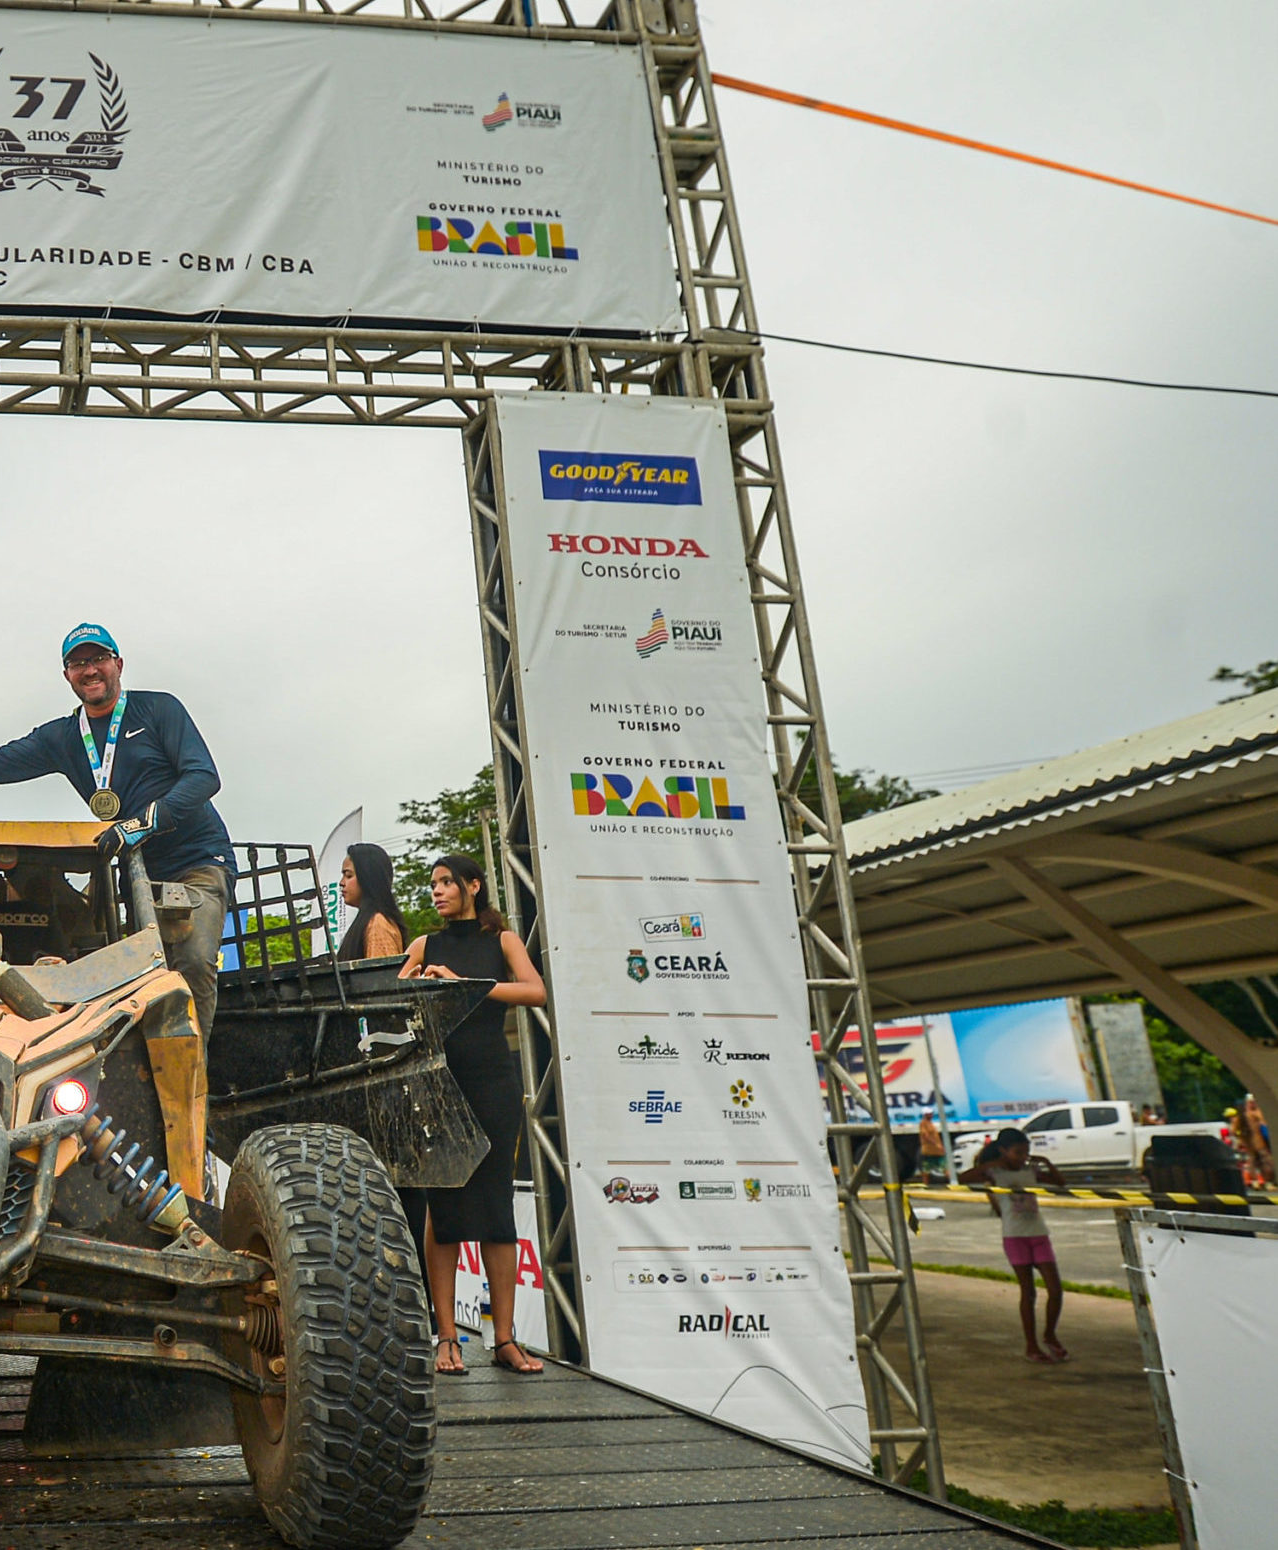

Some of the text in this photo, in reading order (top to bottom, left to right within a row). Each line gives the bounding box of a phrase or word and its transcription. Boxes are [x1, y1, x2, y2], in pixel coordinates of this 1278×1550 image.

[9, 75, 87, 120] 37
[26, 129, 71, 143] anos
[84, 133, 108, 143] 2024
[436, 158, 545, 175] MINISTÉRIO DO
[462, 175, 522, 187] TURISMO
[428, 202, 563, 218] GOVERNO FEDERAL
[416, 215, 579, 261] BRASIL
[178, 252, 236, 274] CBM
[261, 254, 315, 276] CBA
[432, 258, 569, 274] UNIÃO E RECONSTRUÇÃO
[549, 461, 690, 486] GOODYEAR
[583, 486, 659, 497] FAÇA SUA ESTRADA
[547, 533, 710, 558] HONDA
[581, 561, 682, 580] Consórcio
[555, 629, 567, 637] DO
[567, 630, 599, 638] TURISMO
[604, 631, 628, 639] SETUR
[582, 623, 627, 632] SECRETARIA
[672, 626, 723, 641] PIAUÍ
[589, 702, 706, 717] MINISTÉRIO DO
[617, 720, 681, 733] TURISMO
[582, 756, 727, 771] GOVERNO FEDERAL
[570, 772, 747, 821] BRASIL
[590, 824, 735, 838] UNIÃO E RECONSTRUÇÃO
[643, 918, 681, 935] Ceará
[654, 951, 729, 973] CEARÁ
[655, 972, 691, 980] GOVERNO
[702, 973, 731, 981] ESTADO
[628, 1101, 683, 1114] SEBRAE
[722, 1109, 768, 1120] TERESINA
[767, 1184, 802, 1198] PEDRO
